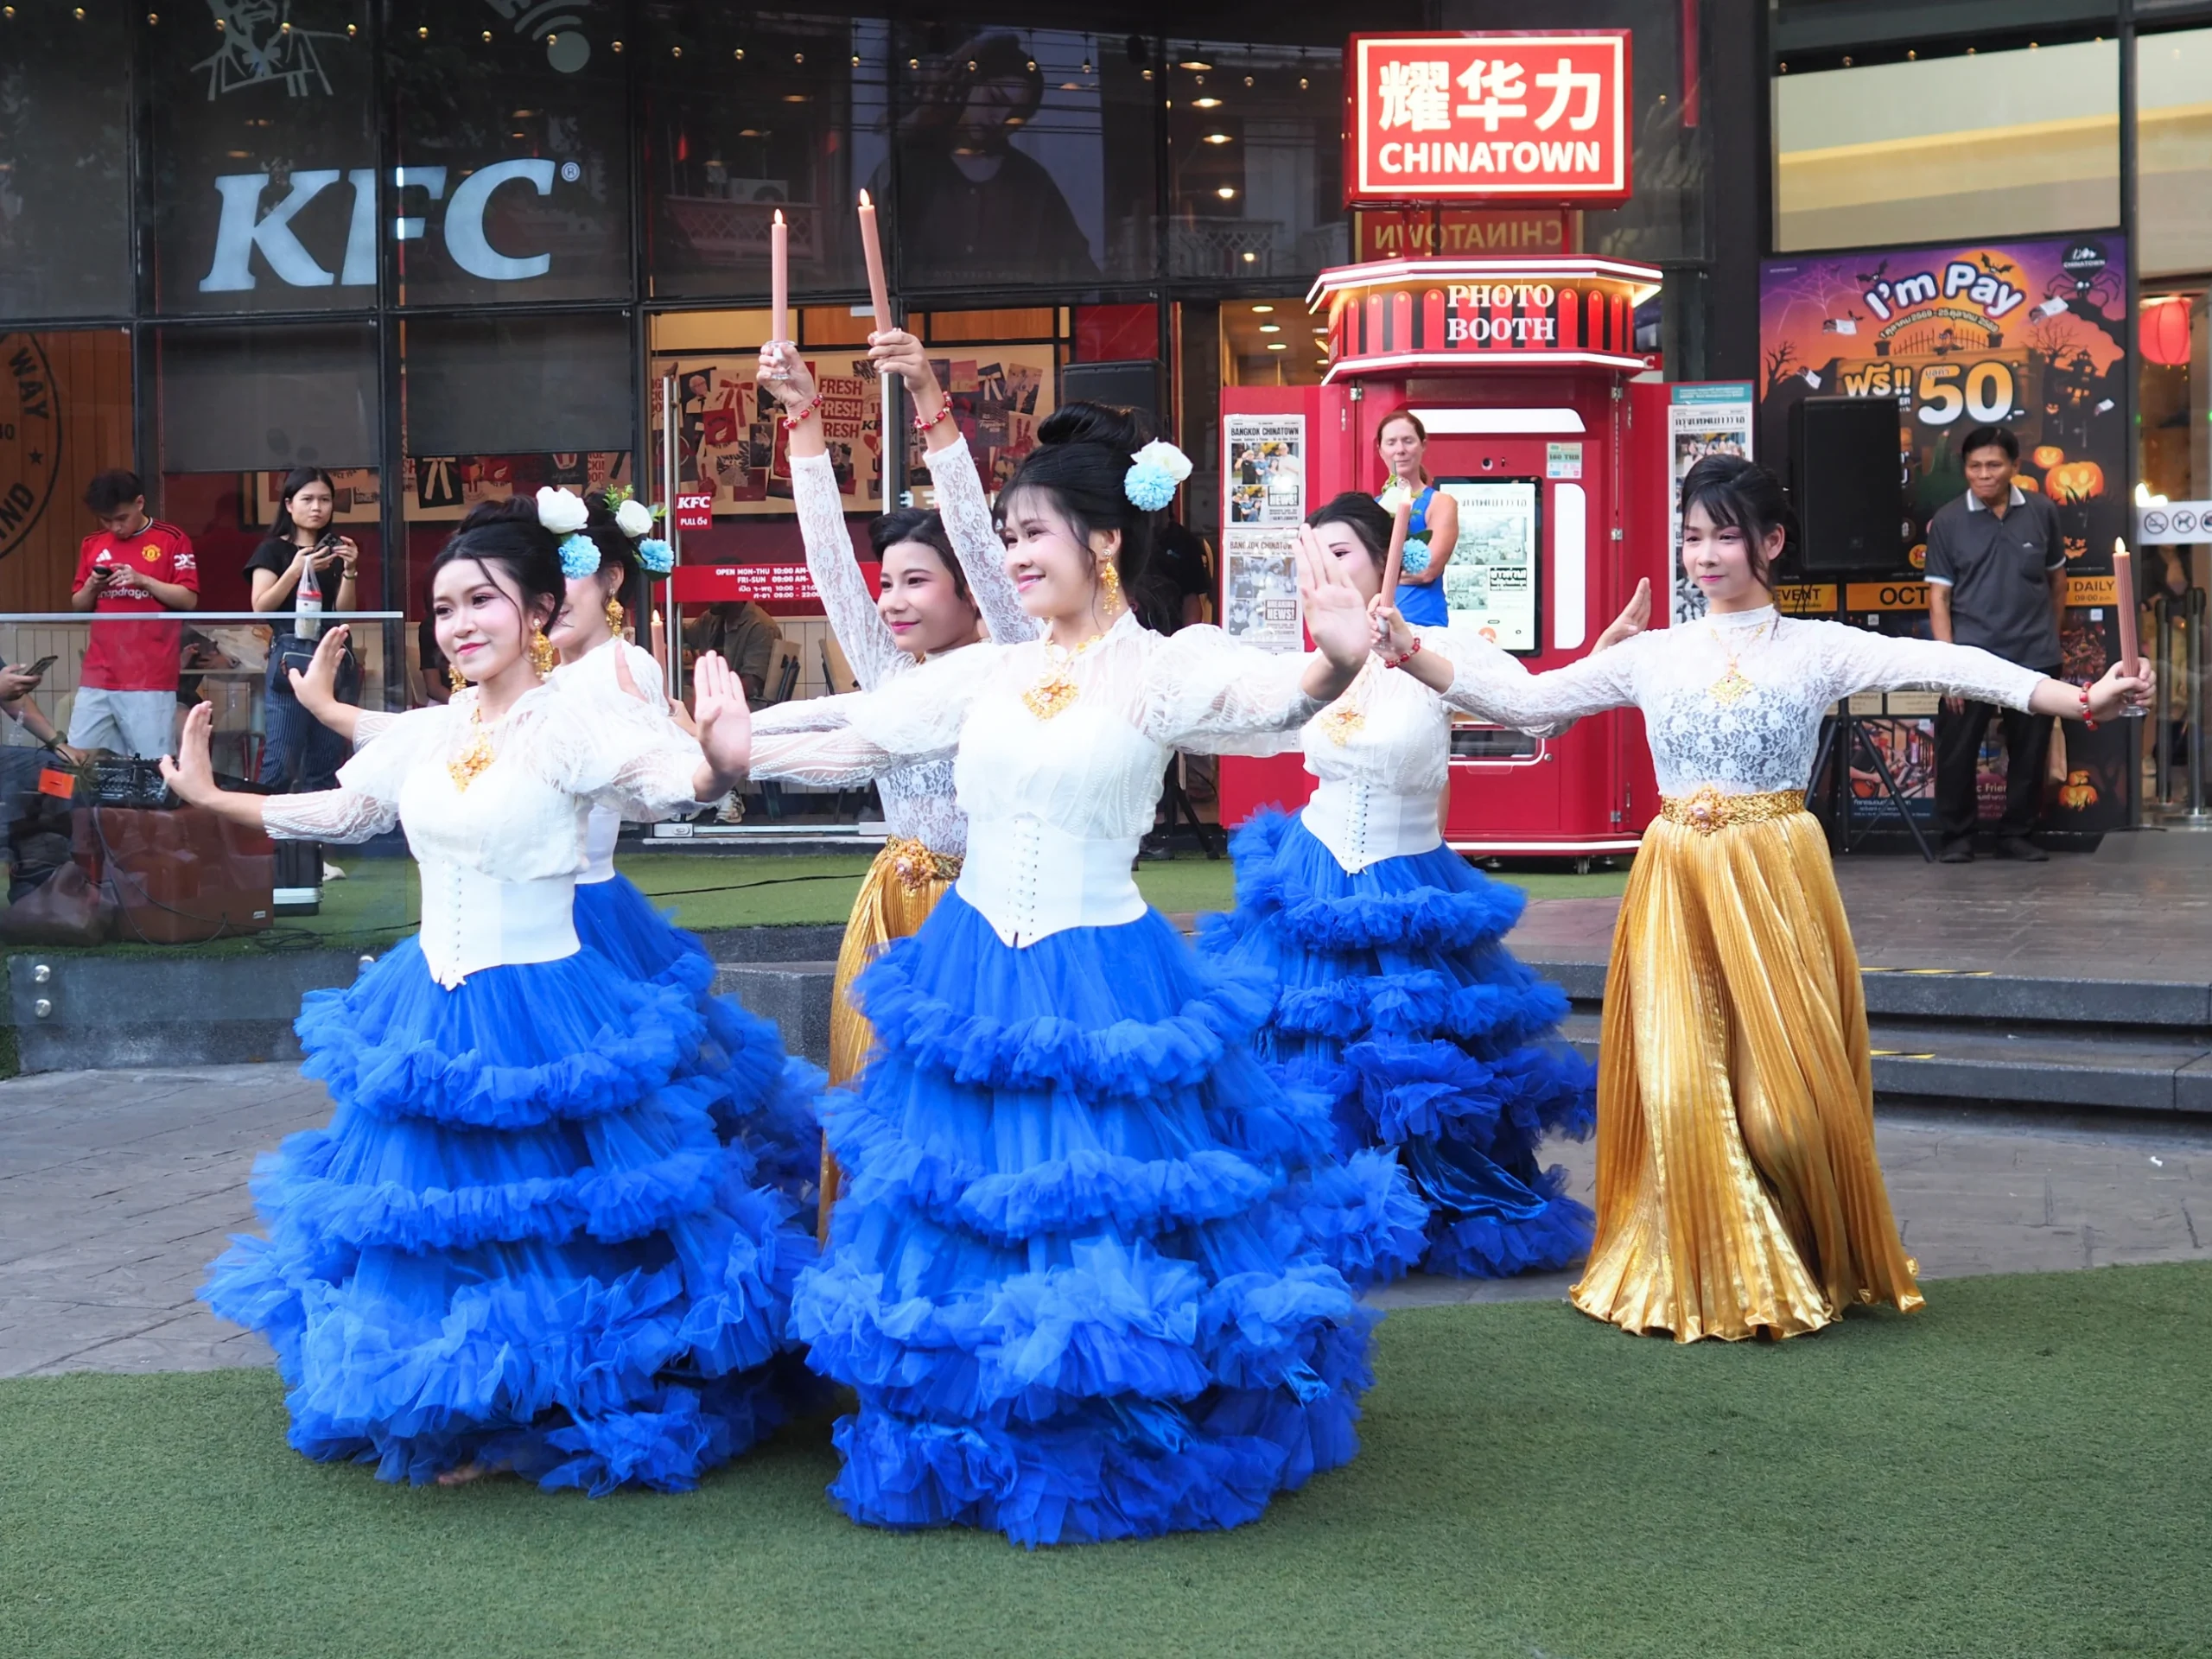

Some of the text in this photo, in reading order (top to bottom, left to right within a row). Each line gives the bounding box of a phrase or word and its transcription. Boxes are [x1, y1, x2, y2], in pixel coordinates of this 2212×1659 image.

[1378, 58, 1601, 132] 耀华力
[1378, 141, 1601, 174] CHINATOWN
[199, 157, 558, 292] KFC
[1446, 283, 1555, 308] PHOTO
[1866, 264, 2024, 321] I'm Pay
[1446, 317, 1555, 340] BOOTH
[9, 346, 49, 420] WAY
[818, 378, 863, 396] FRESH
[822, 422, 860, 439] RESH
[1230, 427, 1300, 436] BANGKOK CHINATOWN
[0, 481, 35, 540] ND
[677, 495, 711, 510] KFC
[680, 518, 696, 526] PULL
[98, 587, 154, 600] napdrago
[1879, 586, 1930, 605] OCT
[2074, 580, 2115, 592] DAILY
[1267, 608, 1295, 620] NEWS!
